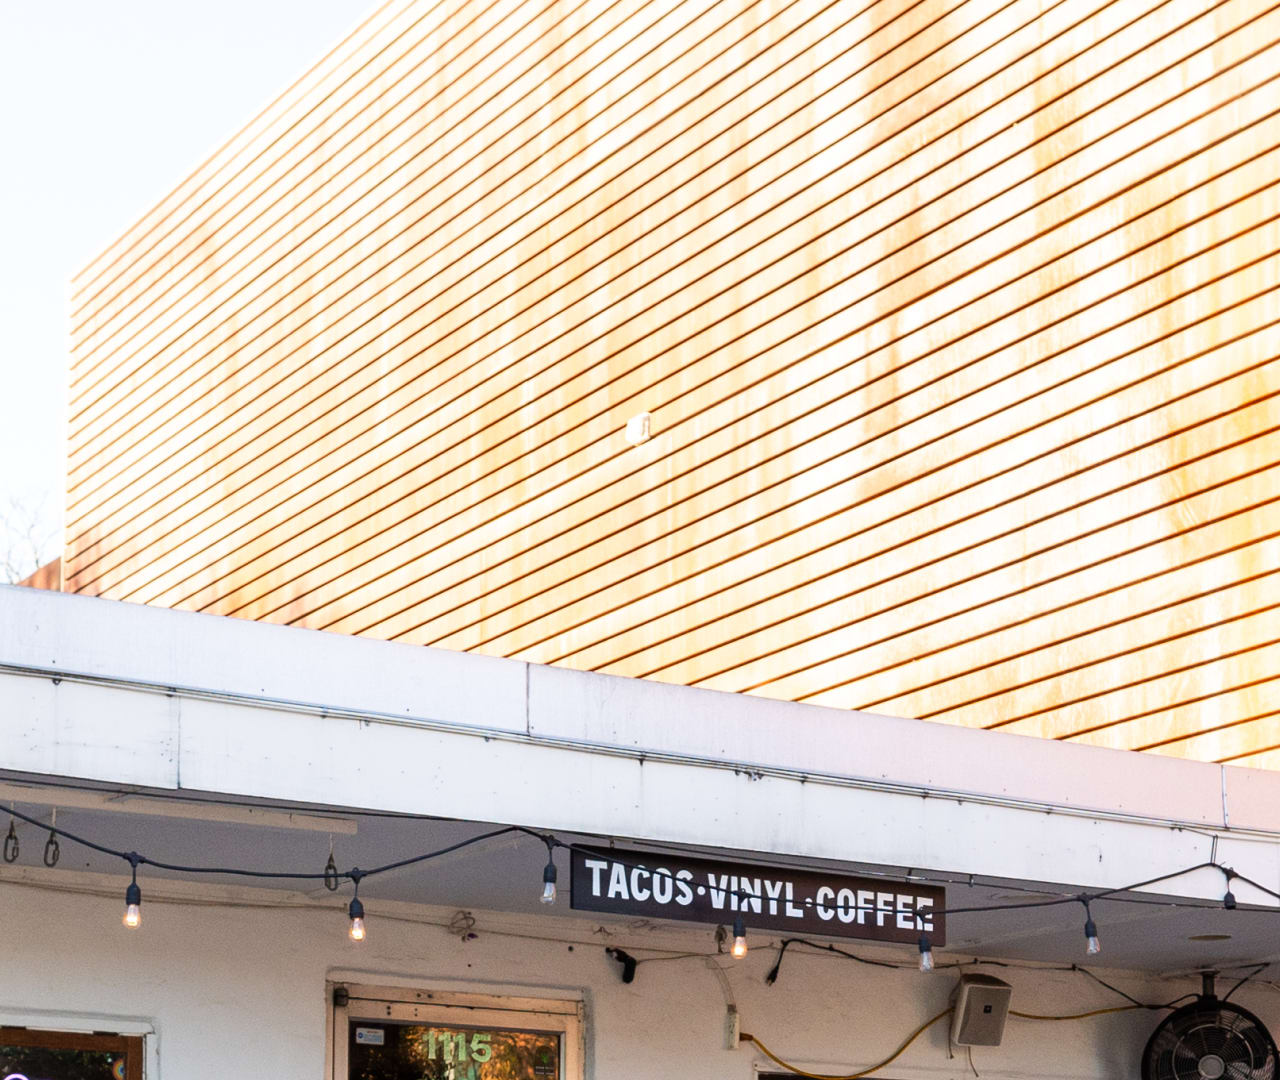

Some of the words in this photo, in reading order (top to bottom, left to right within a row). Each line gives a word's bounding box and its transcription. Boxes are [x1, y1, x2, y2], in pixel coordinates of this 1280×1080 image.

[584, 858, 694, 907] TACOS
[707, 873, 804, 919] VINYL
[816, 885, 935, 932] COFFEE
[423, 1031, 493, 1063] 1115
